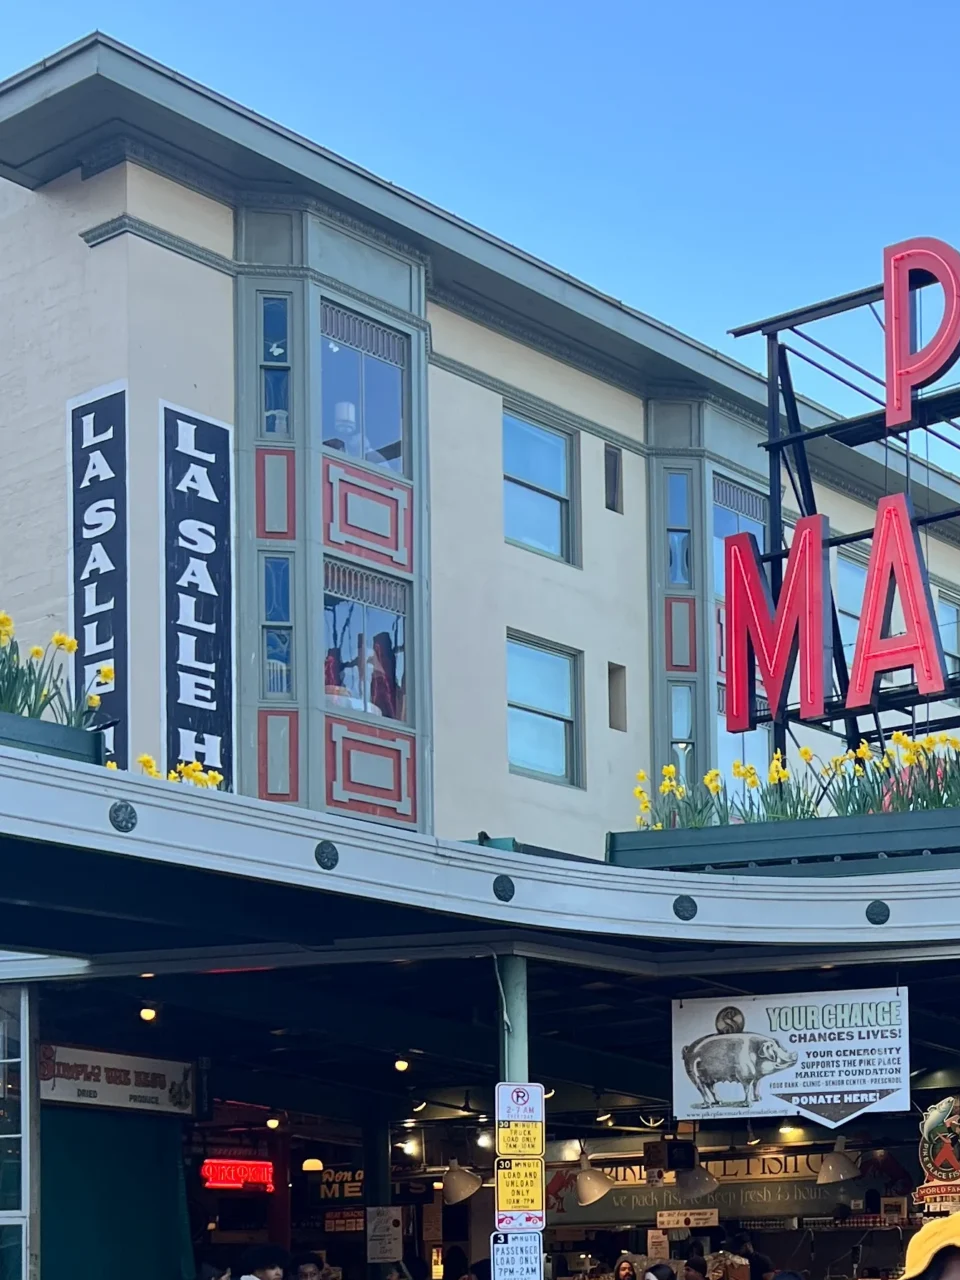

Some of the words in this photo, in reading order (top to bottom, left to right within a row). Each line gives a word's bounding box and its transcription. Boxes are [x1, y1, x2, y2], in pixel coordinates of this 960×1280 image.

[80, 411, 116, 488] LA
[176, 419, 220, 503] LA
[79, 498, 117, 698] SALLE
[176, 518, 219, 711] SALLE
[766, 1005, 820, 1032] YOUR
[822, 1001, 901, 1030] CHANGE
[789, 1031, 855, 1043] CHANGES
[857, 1029, 902, 1040] LIVES!
[806, 1049, 833, 1059] YOUR
[836, 1047, 902, 1057] GENEROSITY
[801, 1059, 840, 1070] SUPPORTS
[843, 1059, 857, 1068] THE
[858, 1058, 876, 1067] PIKE
[878, 1056, 901, 1066] PLACE
[795, 1070, 836, 1079] MARKET
[838, 1067, 902, 1077] FOUNDATION
[803, 1080, 821, 1088] CLINIC
[825, 1079, 845, 1087] SENIOR
[846, 1078, 867, 1086] CENTER
[77, 1088, 98, 1099] DRIED
[129, 1094, 159, 1105] PRODUCE
[791, 1095, 841, 1106] DONATE
[843, 1092, 880, 1103] HERE!
[499, 1160, 511, 1169] 30
[503, 1171, 521, 1179] LOAD
[524, 1171, 537, 1179] AND
[926, 1163, 946, 1180] PLACE
[920, 1186, 946, 1195] WORLD
[497, 1234, 505, 1244] 3
[495, 1246, 538, 1256] PASSENGER
[495, 1256, 516, 1266] LOAD
[519, 1255, 539, 1265] ONLY
[498, 1266, 537, 1277] 7PM-2AM
